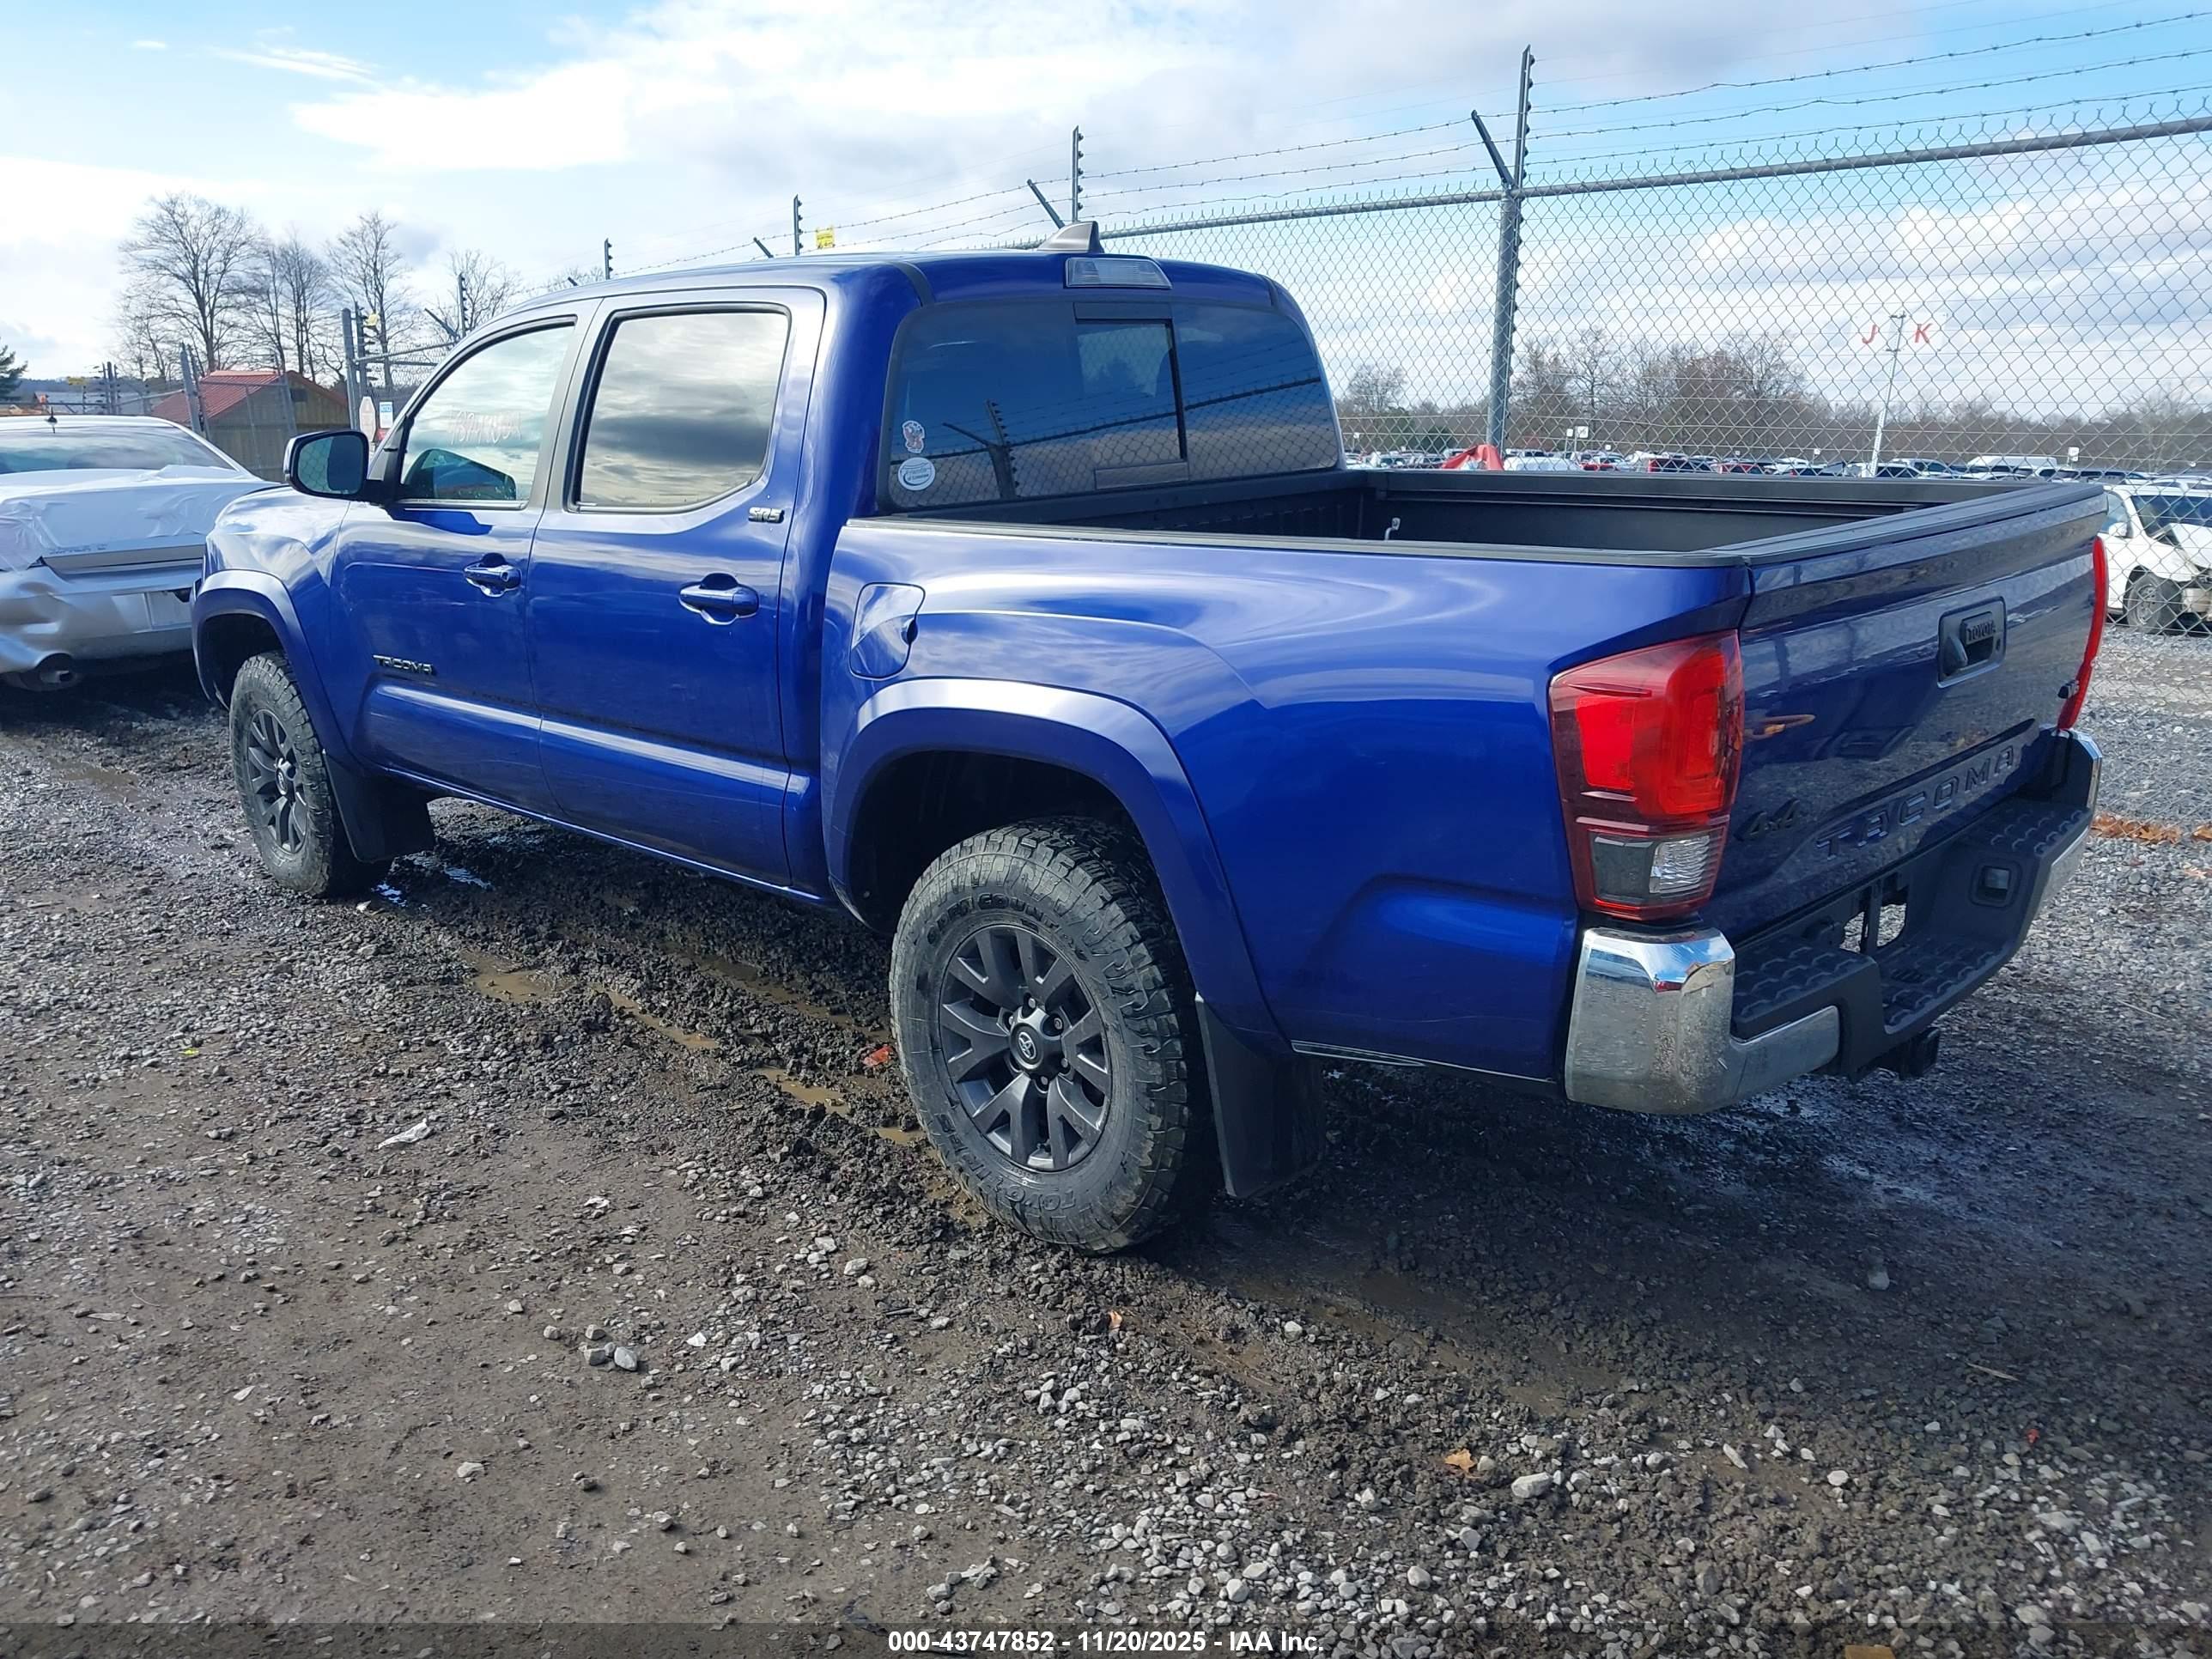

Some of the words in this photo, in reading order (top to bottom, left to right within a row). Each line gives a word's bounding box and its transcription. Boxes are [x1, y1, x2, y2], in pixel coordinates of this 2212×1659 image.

[1861, 323, 1877, 344] J
[1914, 323, 1933, 343] K
[748, 507, 784, 523] SR5
[372, 653, 434, 675] TACOMA
[1815, 745, 2014, 860] TACOMA
